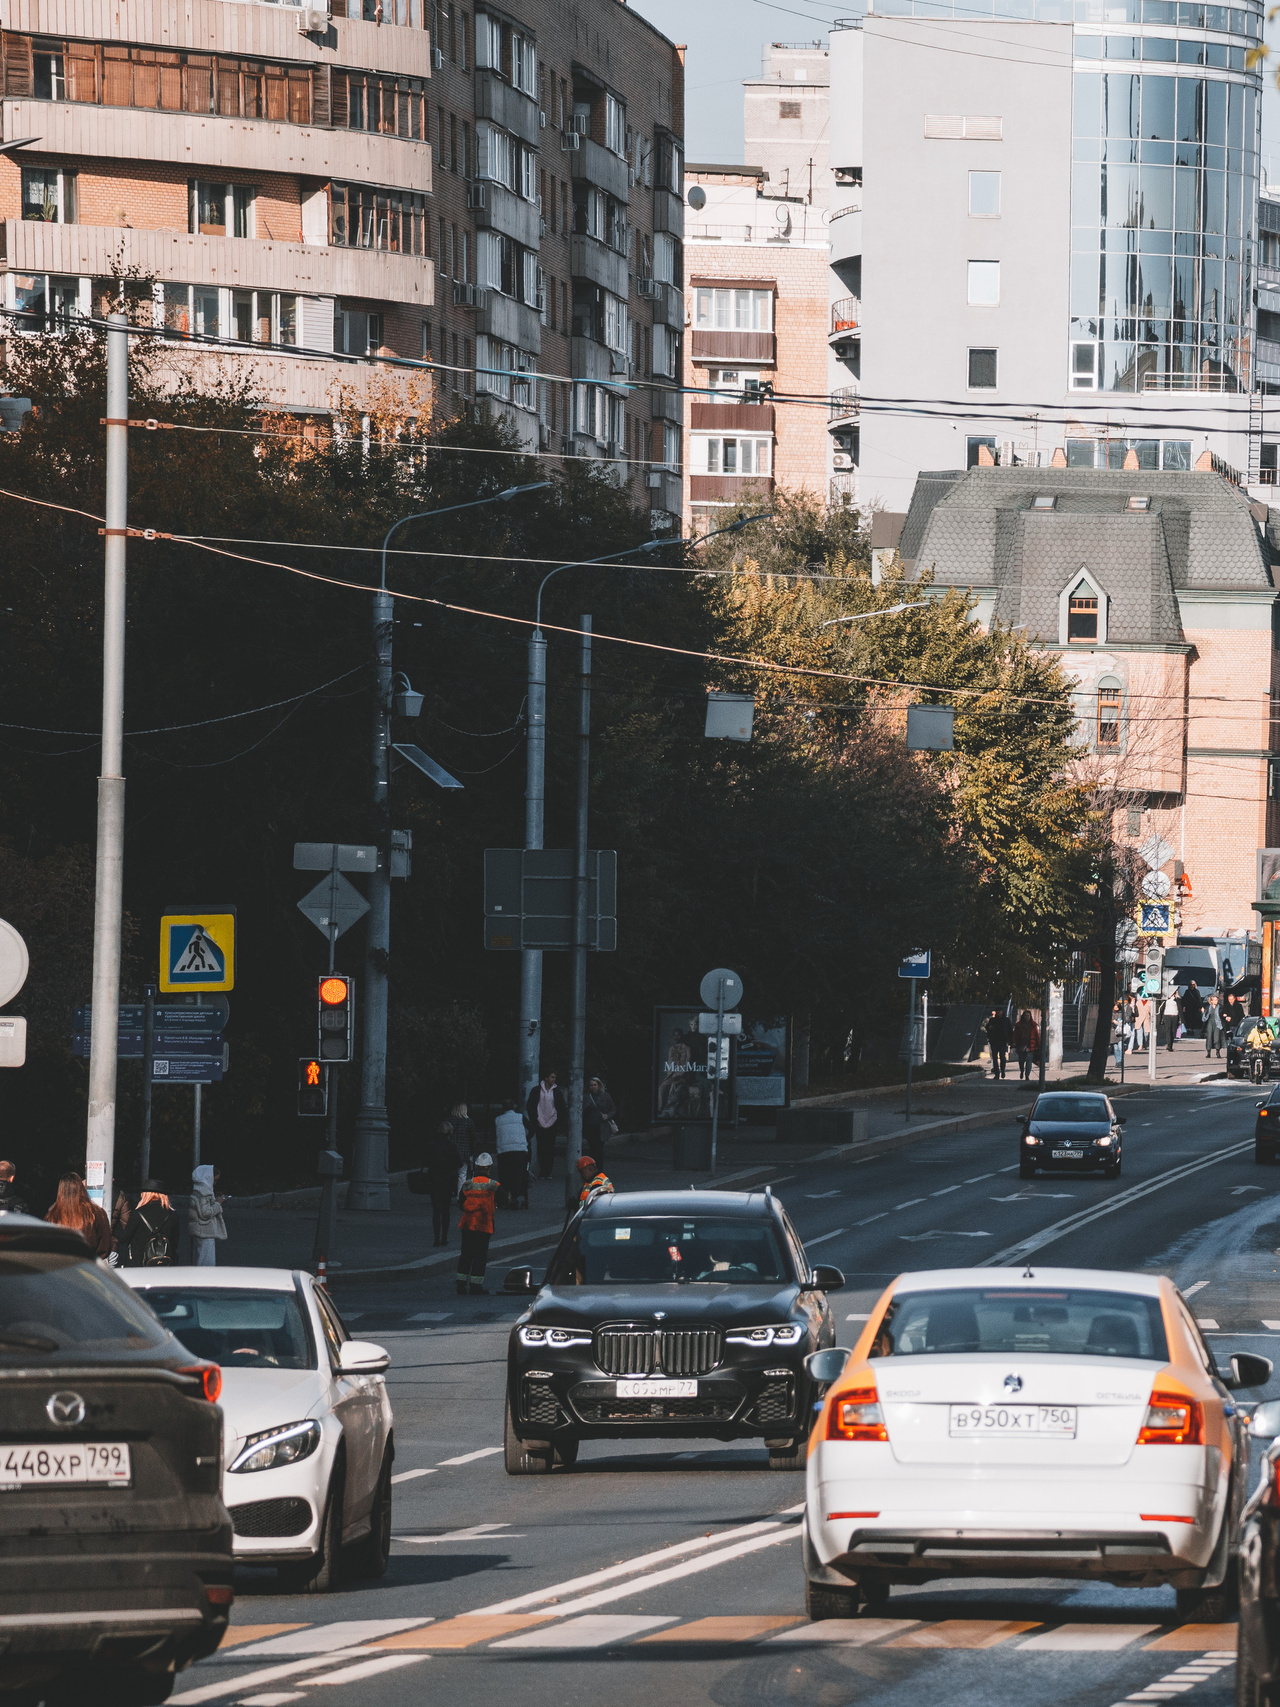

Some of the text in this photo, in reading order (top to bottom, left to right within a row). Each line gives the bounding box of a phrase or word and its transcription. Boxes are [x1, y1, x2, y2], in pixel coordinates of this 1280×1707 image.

[1041, 1408, 1071, 1424] 750
[0, 1446, 122, 1478] 448ХР 799
